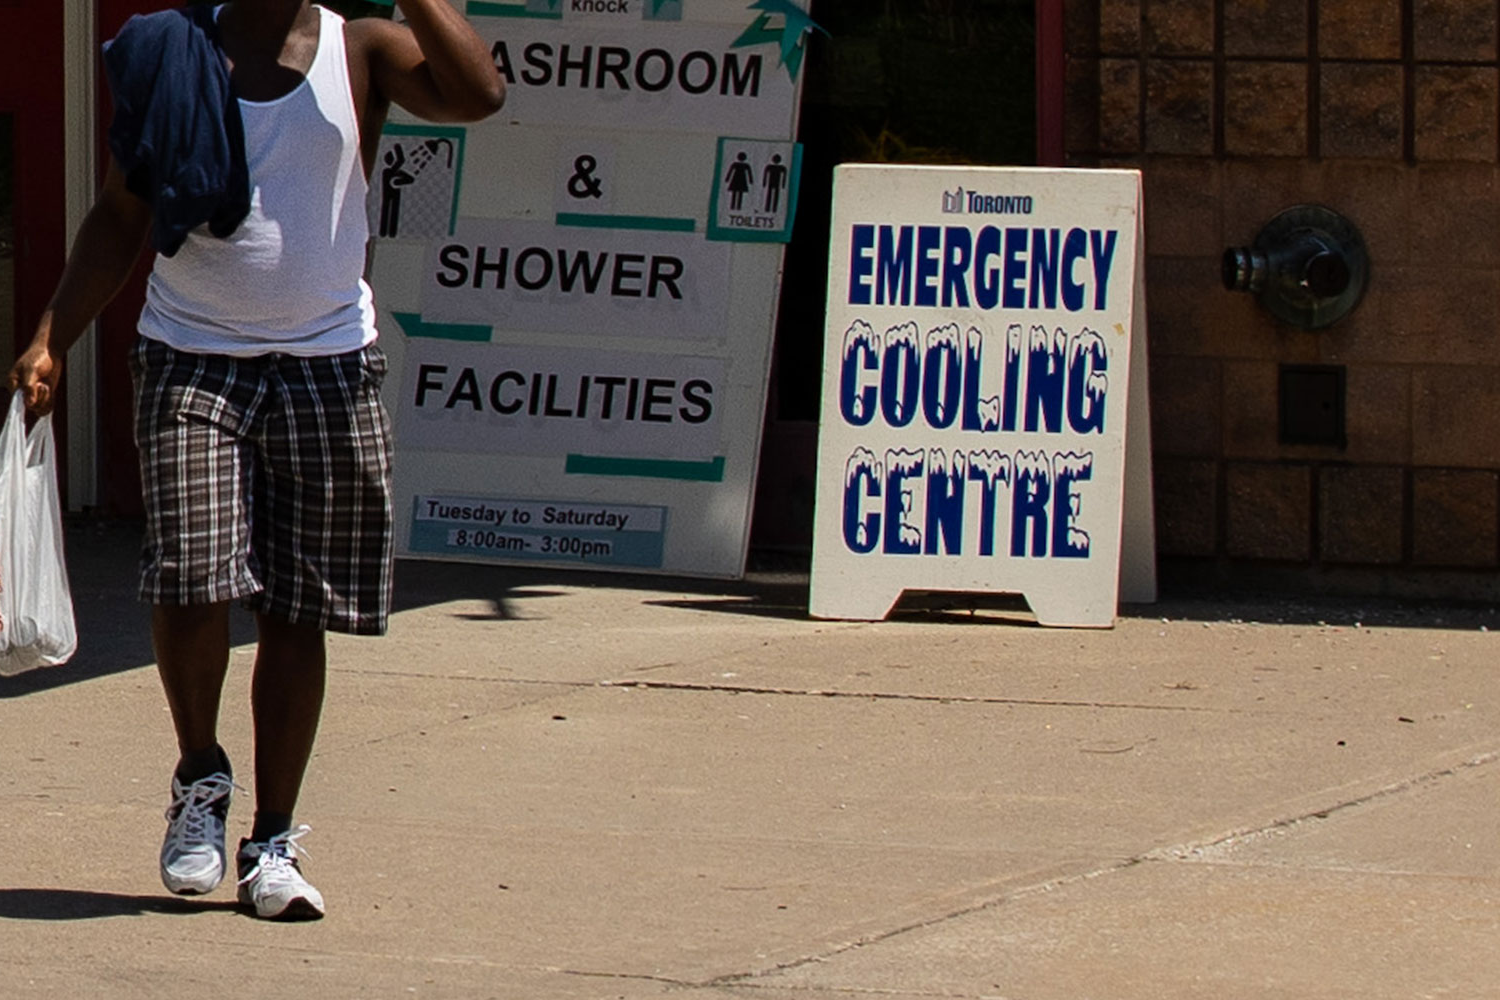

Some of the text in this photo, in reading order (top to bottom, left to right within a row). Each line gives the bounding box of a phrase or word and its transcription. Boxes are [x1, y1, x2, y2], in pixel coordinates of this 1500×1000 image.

[490, 41, 763, 98] ASHROOM
[567, 154, 603, 199] &
[966, 190, 1033, 215] TORONTO
[729, 213, 775, 229] TOILETS
[436, 244, 685, 300] SHOWER
[847, 224, 1118, 312] EMERGENCY
[414, 364, 713, 424] FACILITIES
[839, 319, 1108, 435] COOLING
[427, 501, 629, 532] Tuesday to Saturday
[842, 446, 1094, 559] CENTRE
[540, 536, 610, 559] 3:00pm
